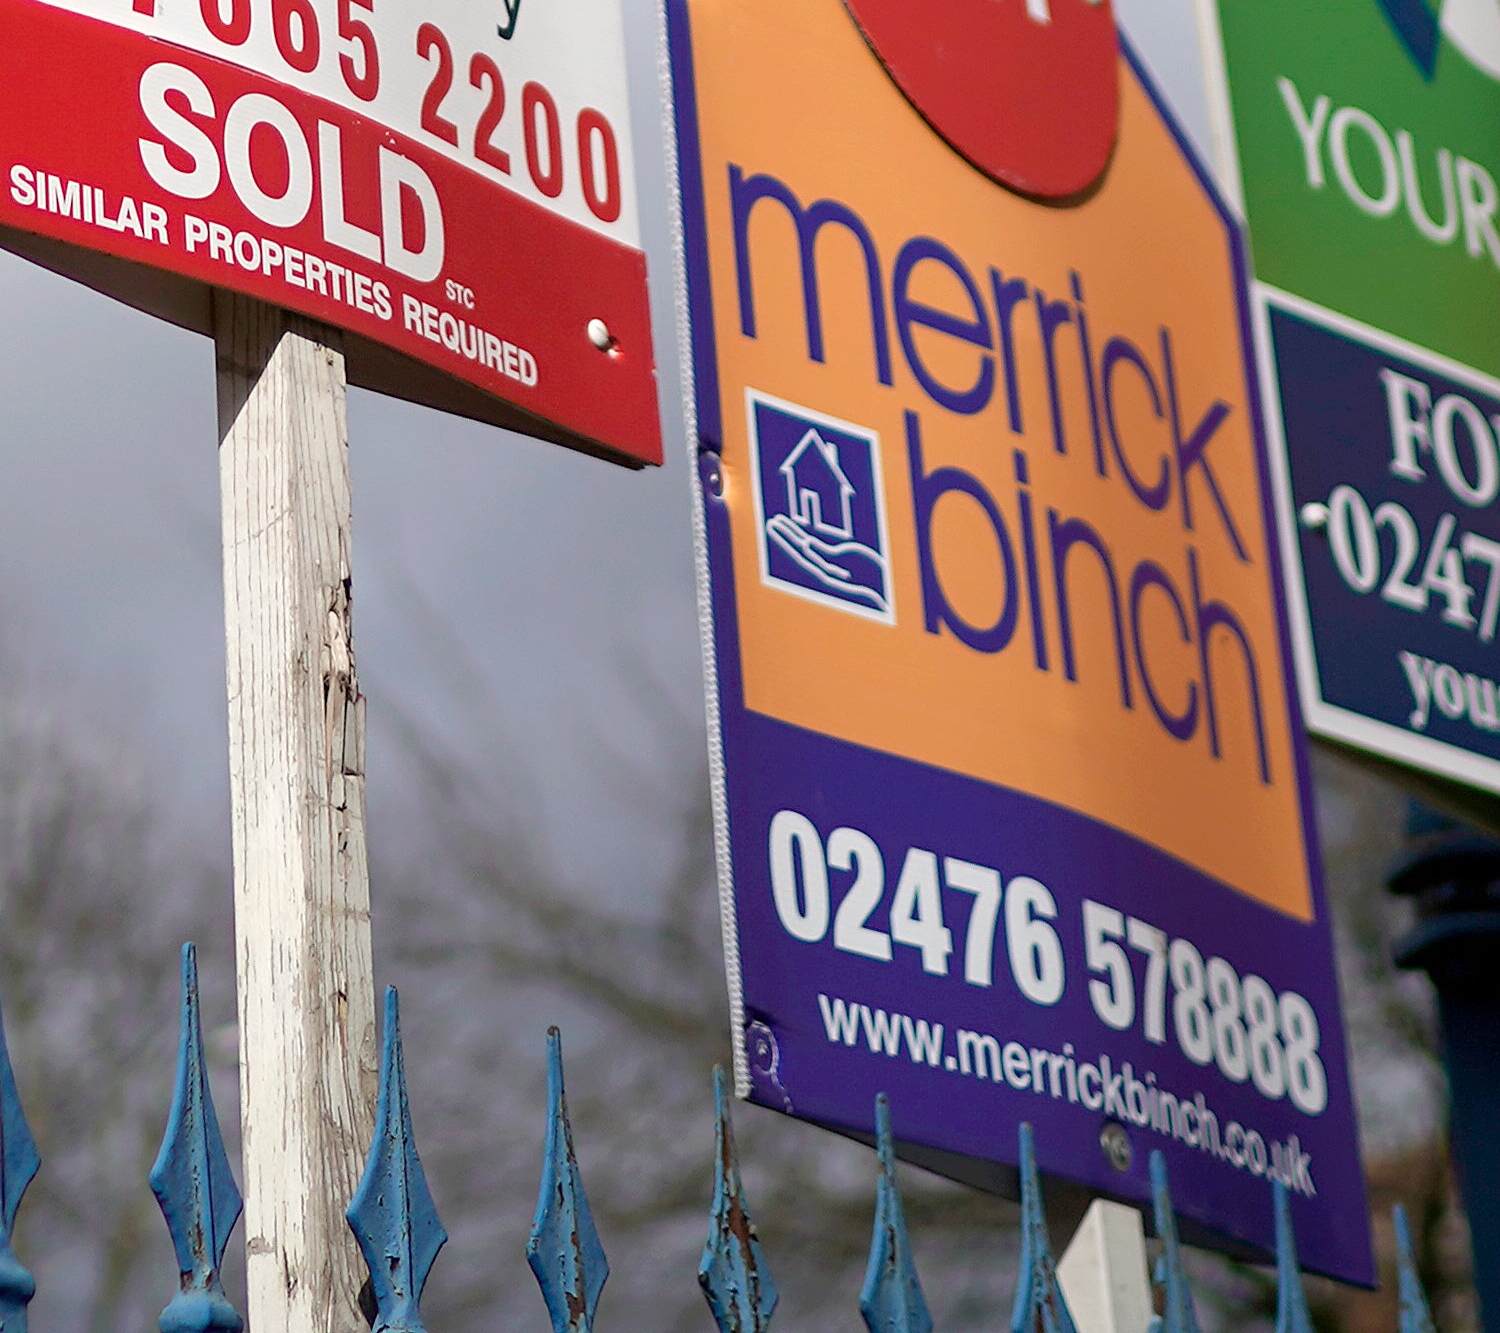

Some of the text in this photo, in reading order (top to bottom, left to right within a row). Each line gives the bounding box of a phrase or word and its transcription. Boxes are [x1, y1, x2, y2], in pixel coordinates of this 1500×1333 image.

[137, 61, 476, 310] SOLD STC
[416, 22, 620, 224] 2200
[9, 165, 538, 388] SIMILAR PROPERTIES REQUIRED
[728, 163, 1254, 565] merrick
[904, 411, 1272, 785] binch
[769, 809, 1328, 1115] 02476 578888
[818, 993, 1316, 1196] www.merrickbinch.co.uk
